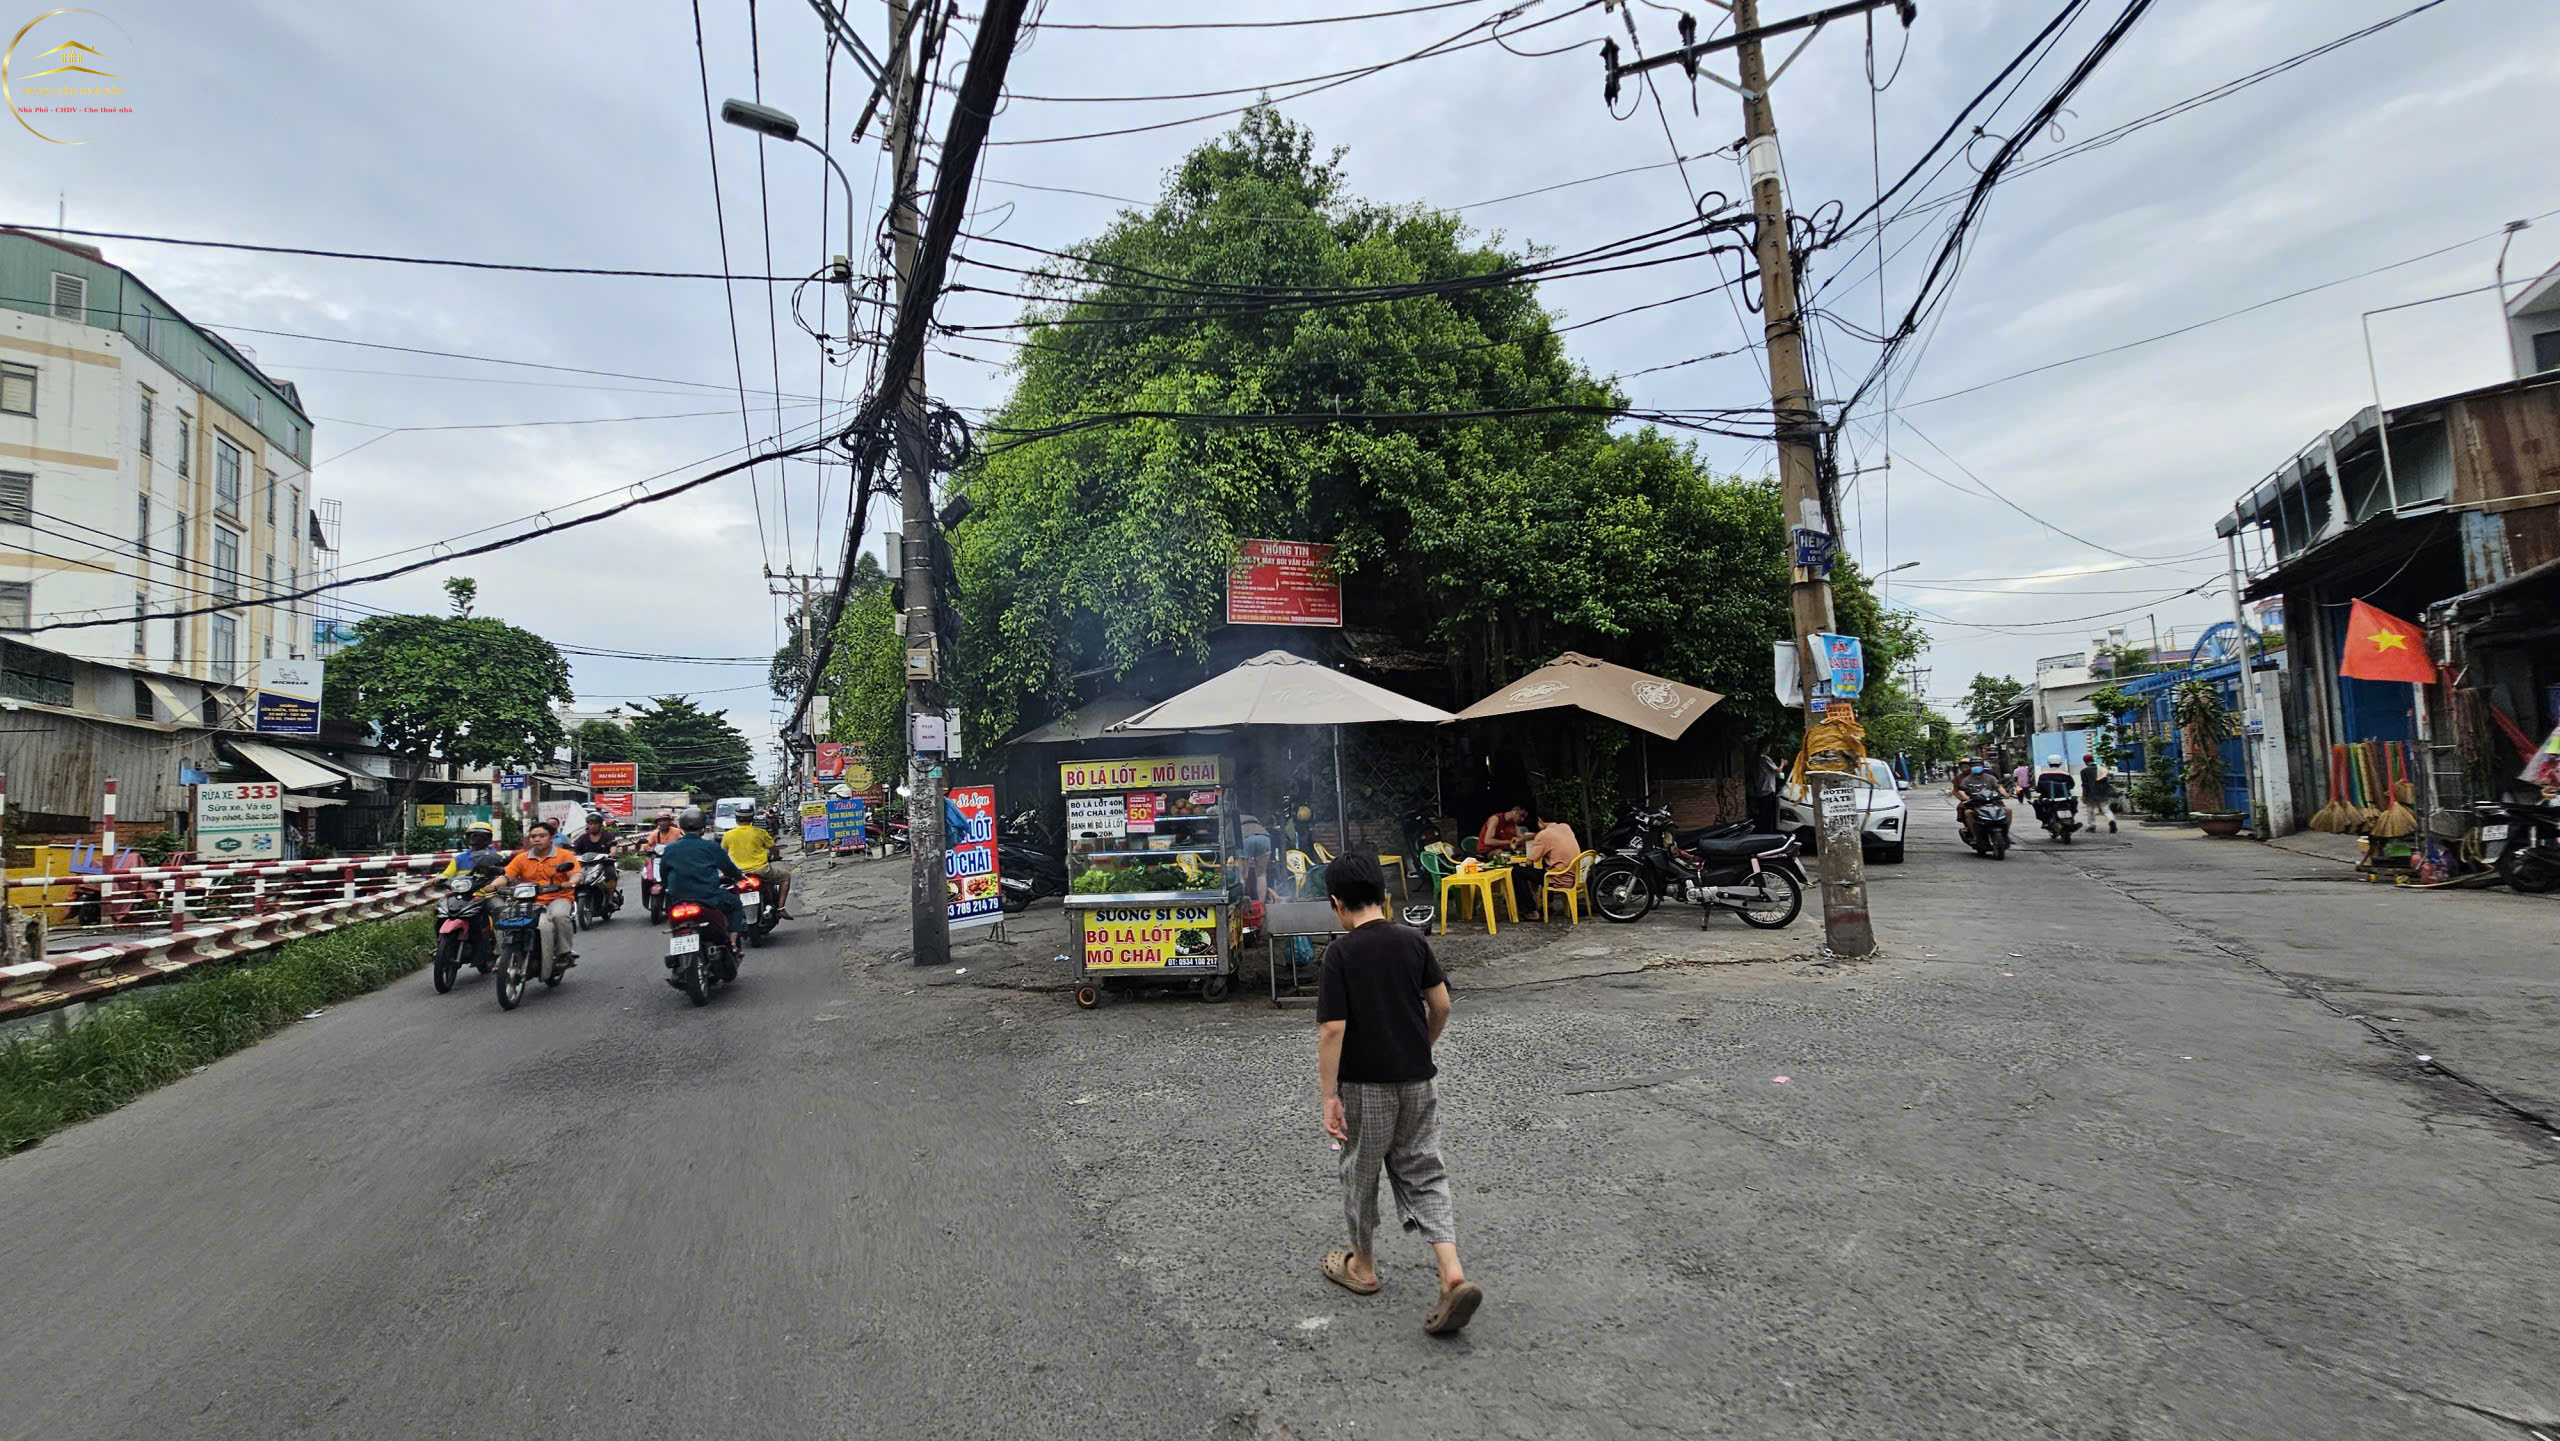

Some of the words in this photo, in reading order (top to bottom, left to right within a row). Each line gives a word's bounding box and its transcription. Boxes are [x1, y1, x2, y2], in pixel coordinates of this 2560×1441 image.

[1294, 546, 1309, 556] TIN
[1067, 766, 1085, 786] BÒ
[1090, 765, 1107, 785] LÁ
[1111, 763, 1137, 784] LỐT
[201, 788, 220, 800] RỬA
[222, 791, 234, 800] XE
[236, 785, 279, 799] 333
[207, 804, 227, 812] Sửa
[1070, 800, 1081, 809] BÒ
[201, 814, 220, 823] Thay
[959, 846, 990, 875] CHÀI
[956, 901, 972, 915] 789
[972, 899, 988, 913] 214
[988, 897, 999, 910] 79
[1156, 908, 1172, 921] SI
[1176, 907, 1209, 923] SỌN
[1086, 926, 1109, 943] BÒ
[1115, 926, 1136, 943] LÁ
[1141, 923, 1173, 942] LỐT
[1120, 945, 1162, 962] CHÀI
[1178, 958, 1194, 966] 0934
